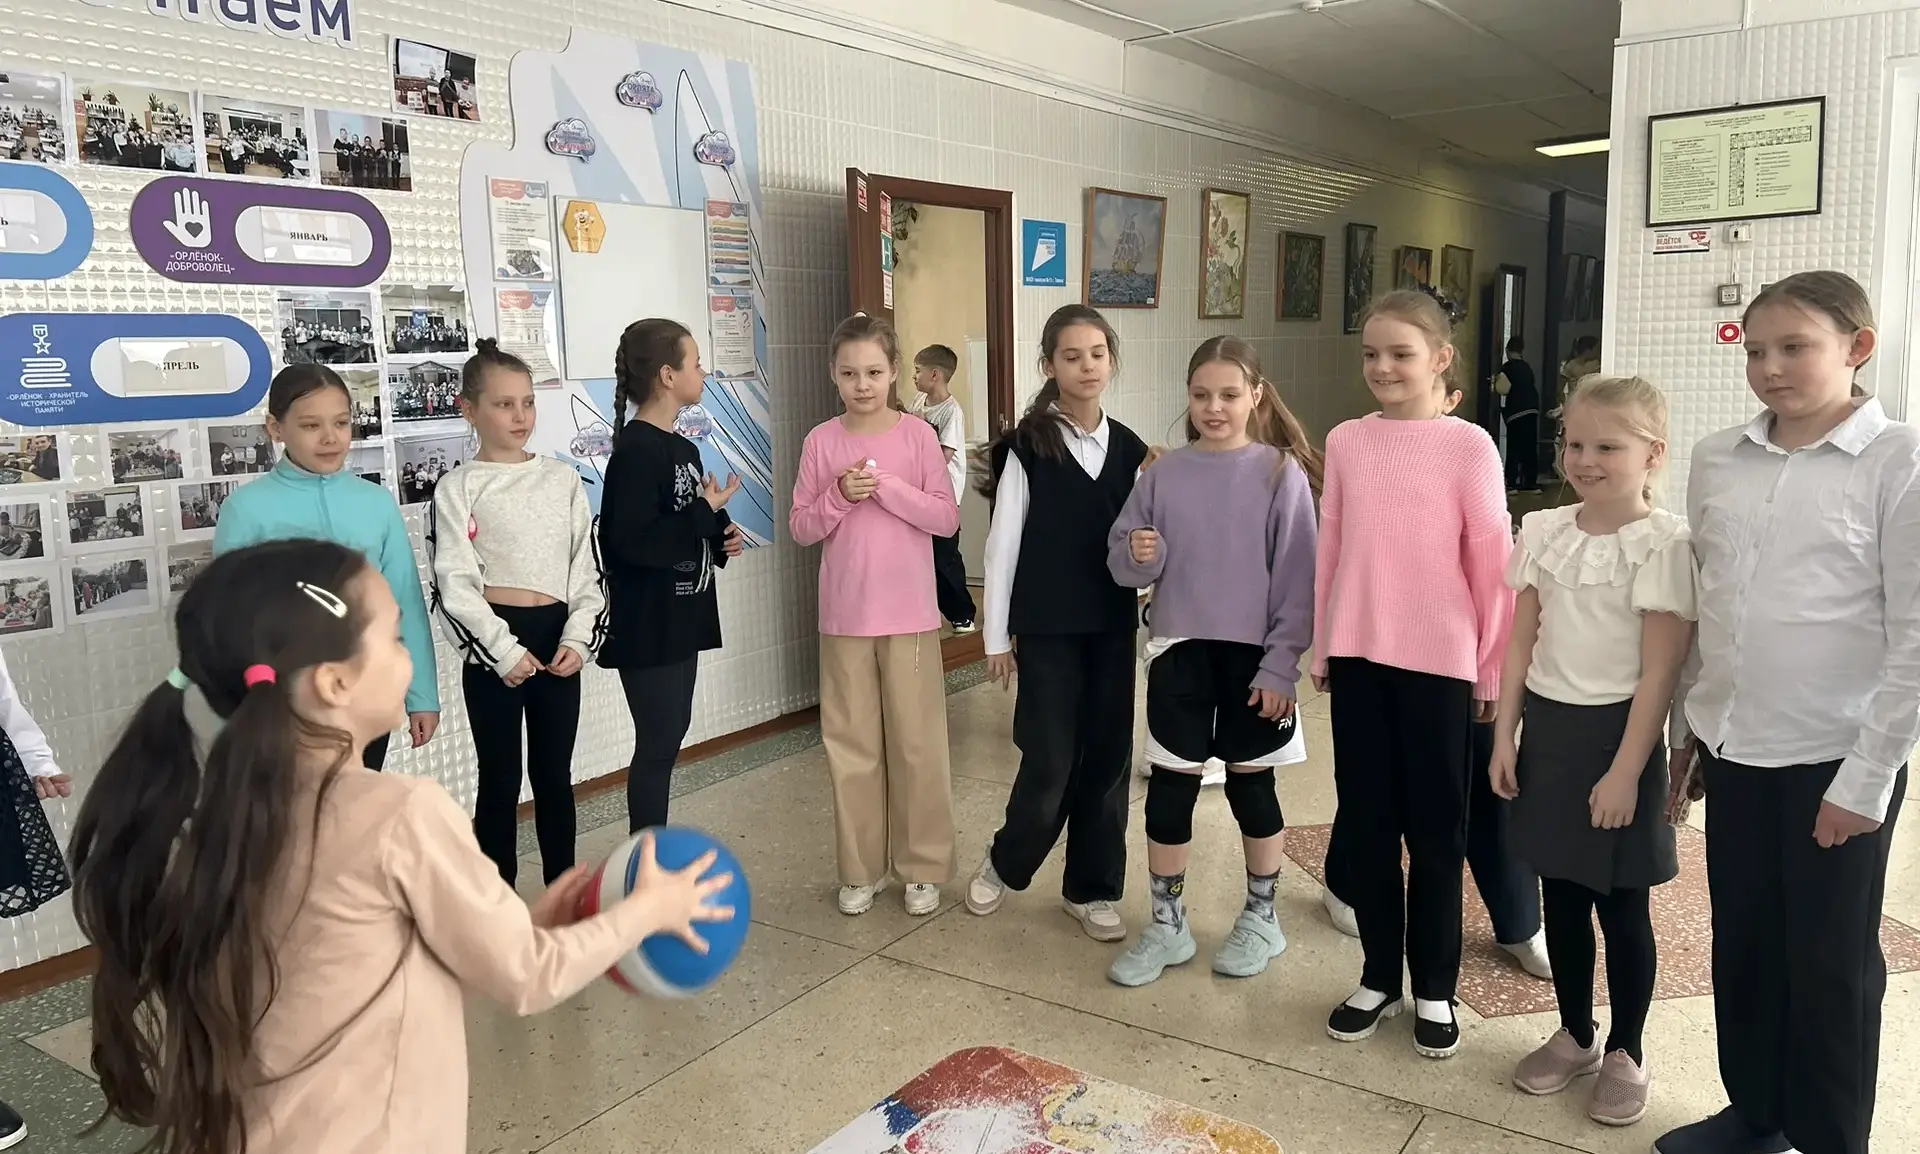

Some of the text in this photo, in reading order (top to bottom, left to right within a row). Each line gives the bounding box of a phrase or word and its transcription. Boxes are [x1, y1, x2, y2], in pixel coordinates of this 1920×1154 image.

[289, 231, 329, 241] ЯНВАРЬ
[49, 391, 89, 399] ХРАНИТЕЛЬ
[20, 398, 76, 407] ИСТОРИЧЕСКОЙ
[35, 406, 64, 414] ПАМЯТИ
